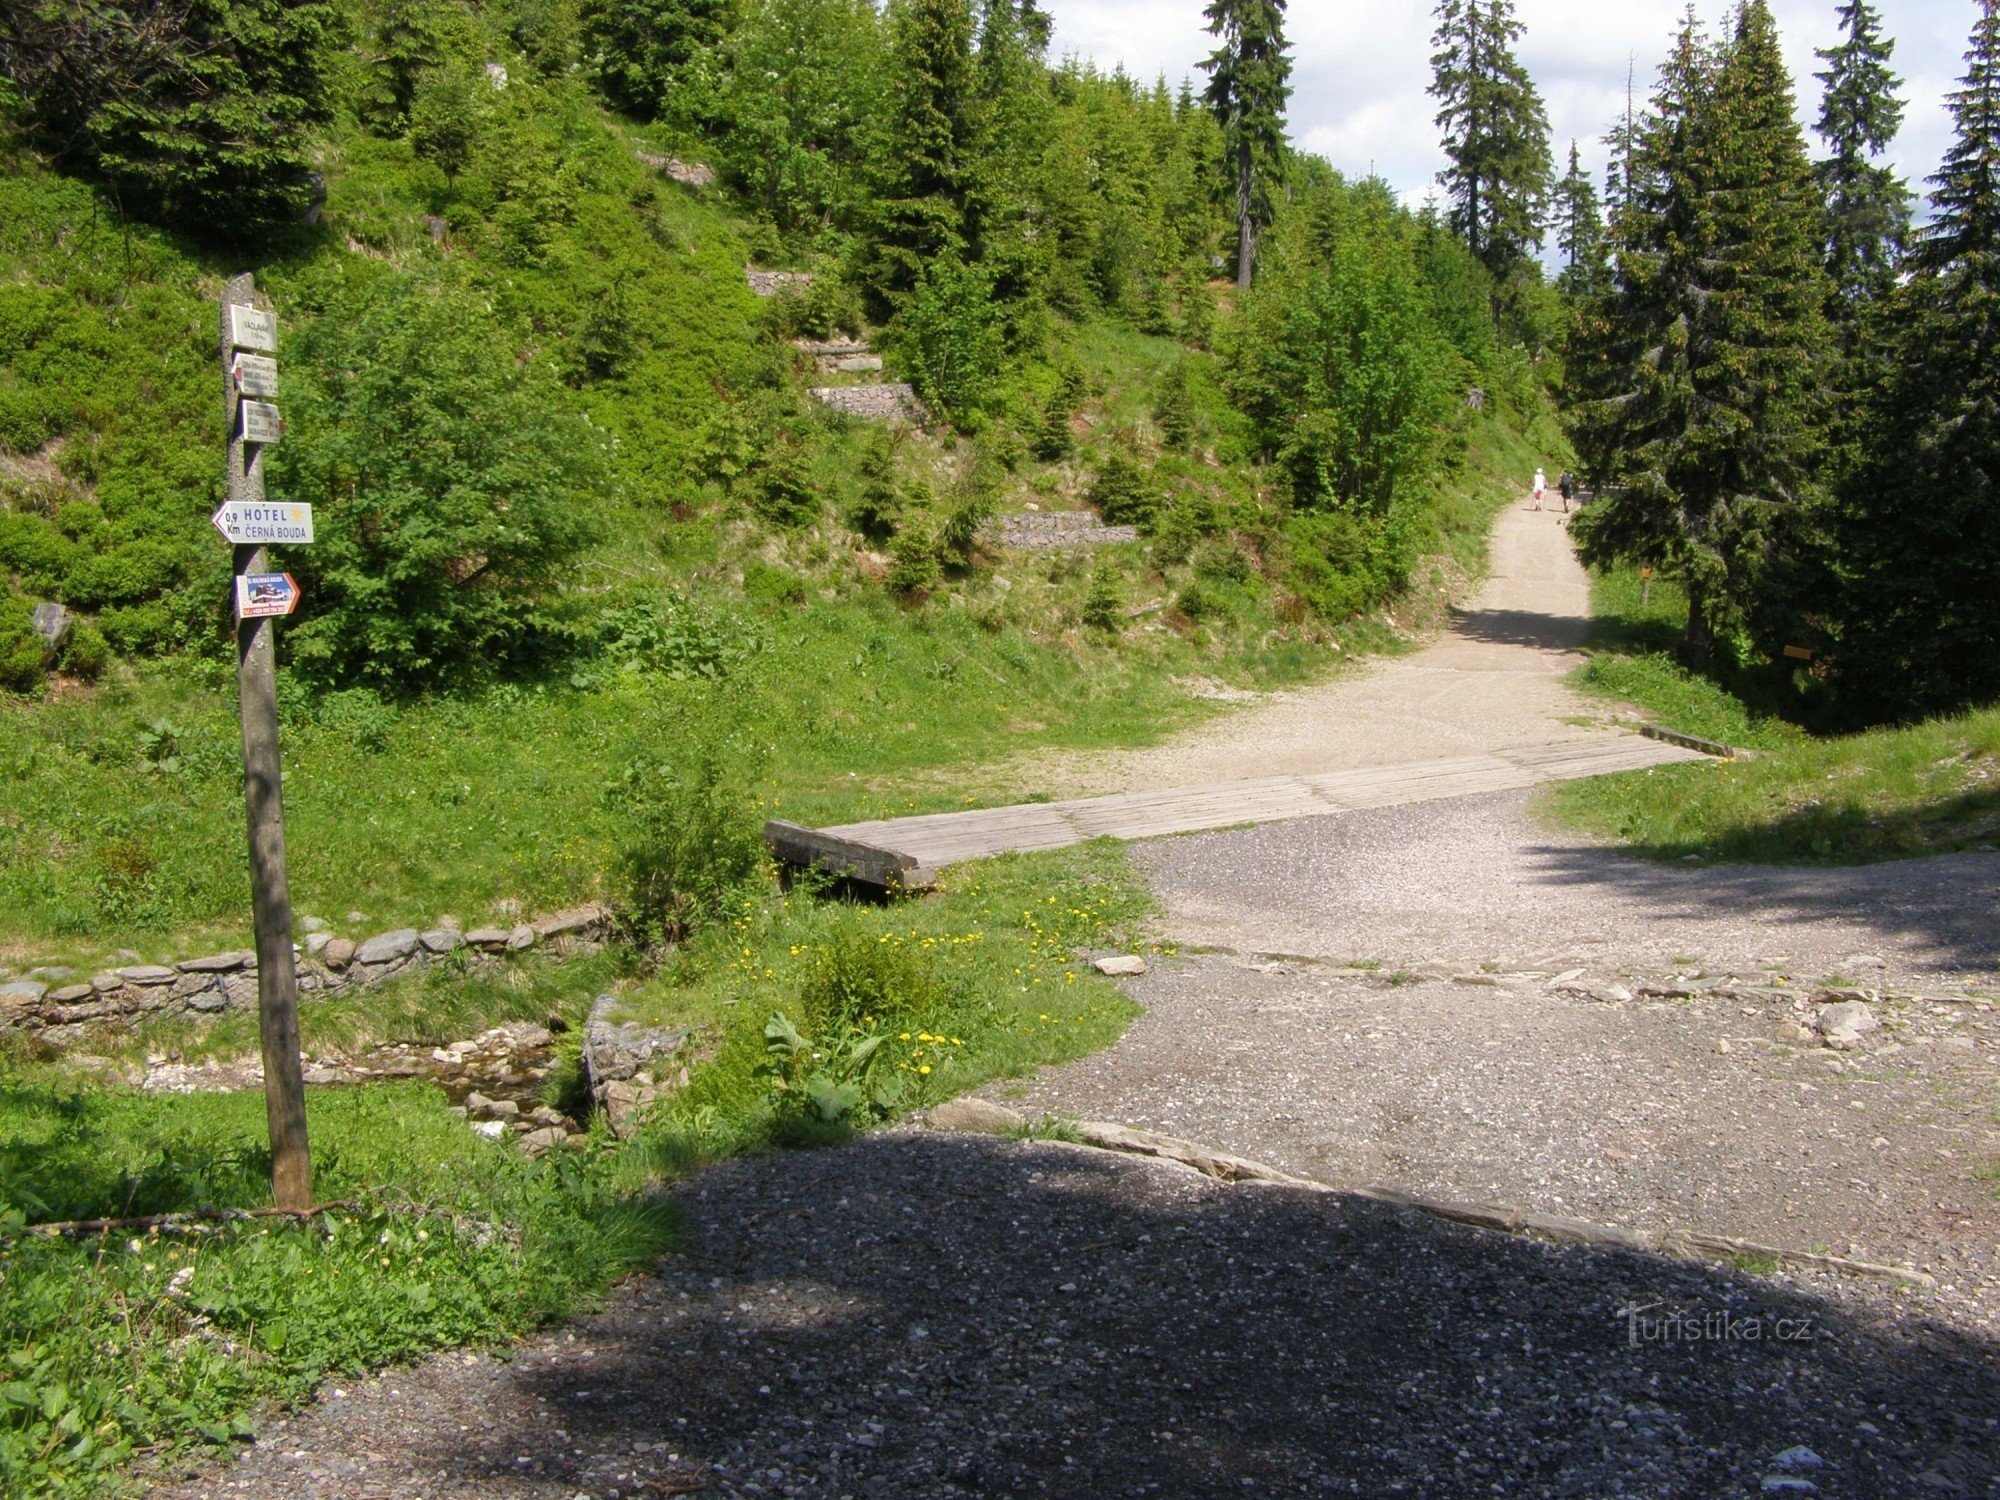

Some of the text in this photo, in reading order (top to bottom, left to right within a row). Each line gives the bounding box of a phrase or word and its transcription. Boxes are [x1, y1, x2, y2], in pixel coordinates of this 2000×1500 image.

[244, 509, 287, 521] HOTEL
[227, 524, 241, 534] Km
[245, 524, 307, 538] ČERNÁ BOUDA
